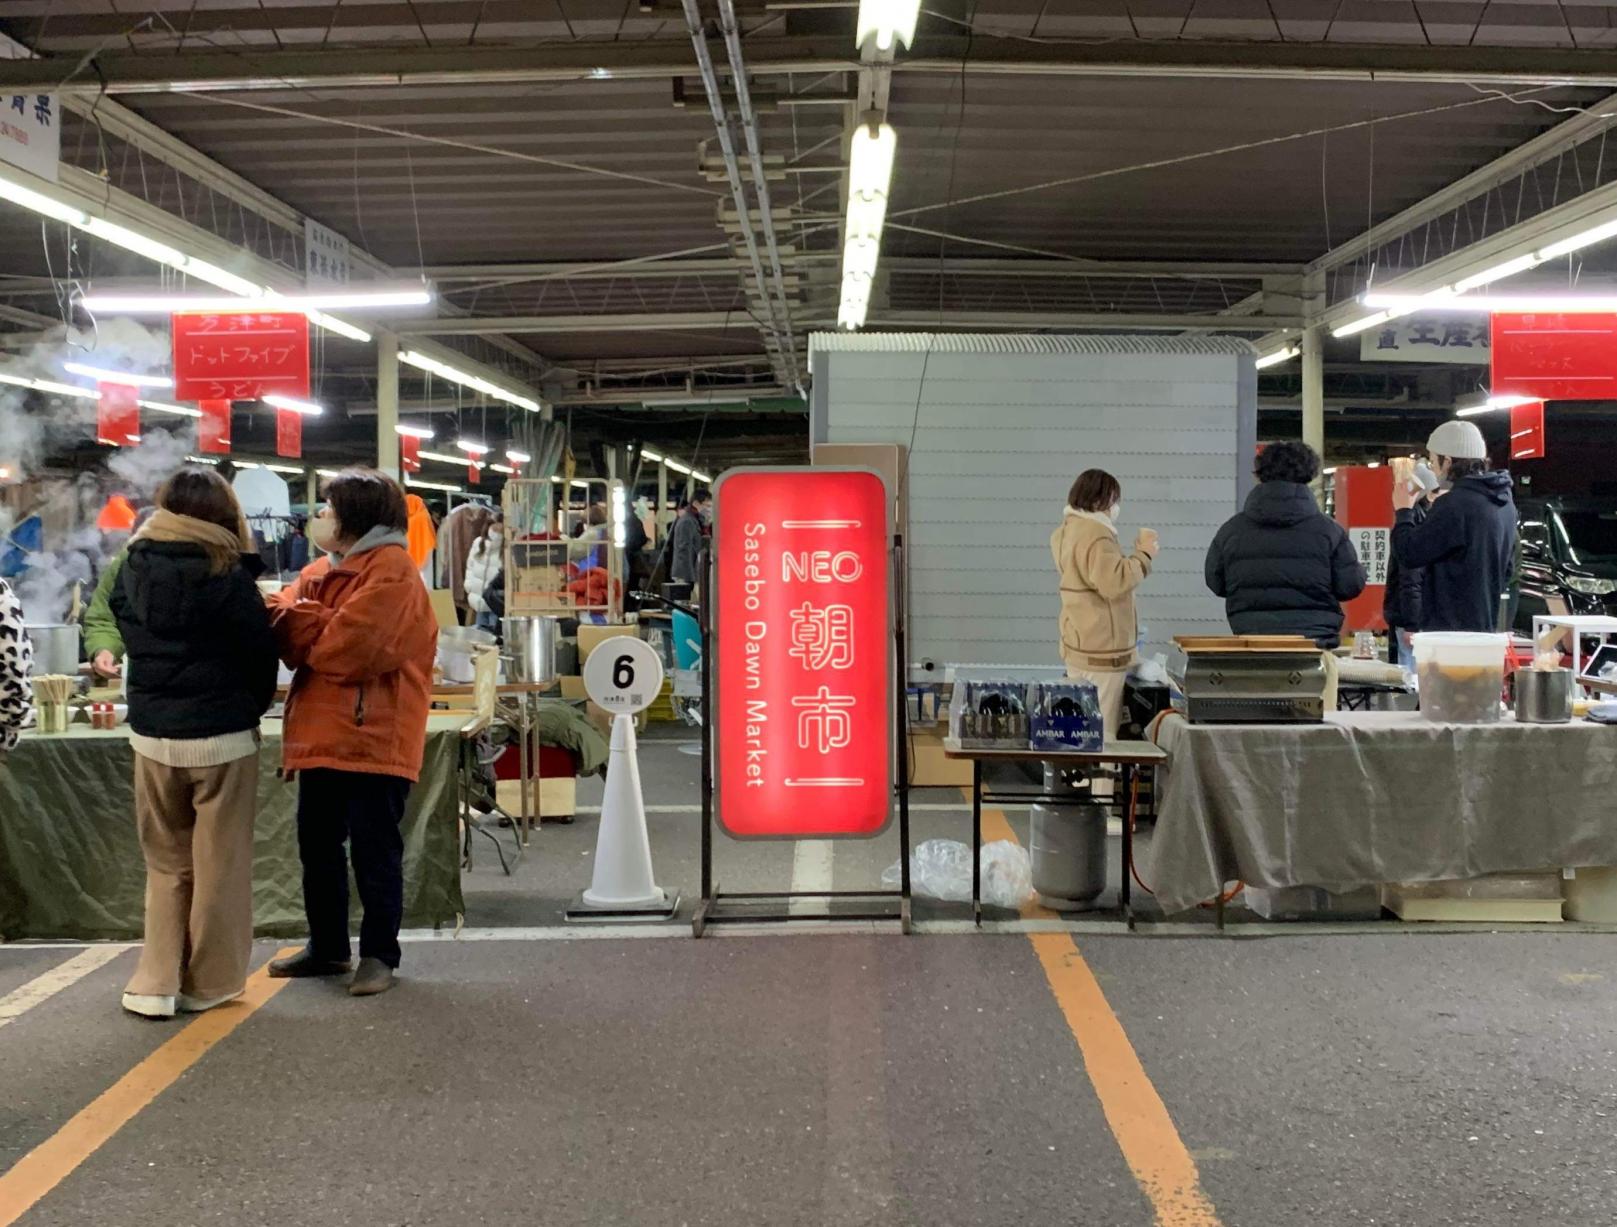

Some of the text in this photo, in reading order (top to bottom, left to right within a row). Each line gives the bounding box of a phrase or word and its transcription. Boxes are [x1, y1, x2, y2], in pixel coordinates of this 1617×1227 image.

[781, 550, 863, 584] NEO
[612, 654, 635, 690] 6
[743, 522, 769, 788] Sasebo Dawn Market
[788, 601, 857, 755] 朝市
